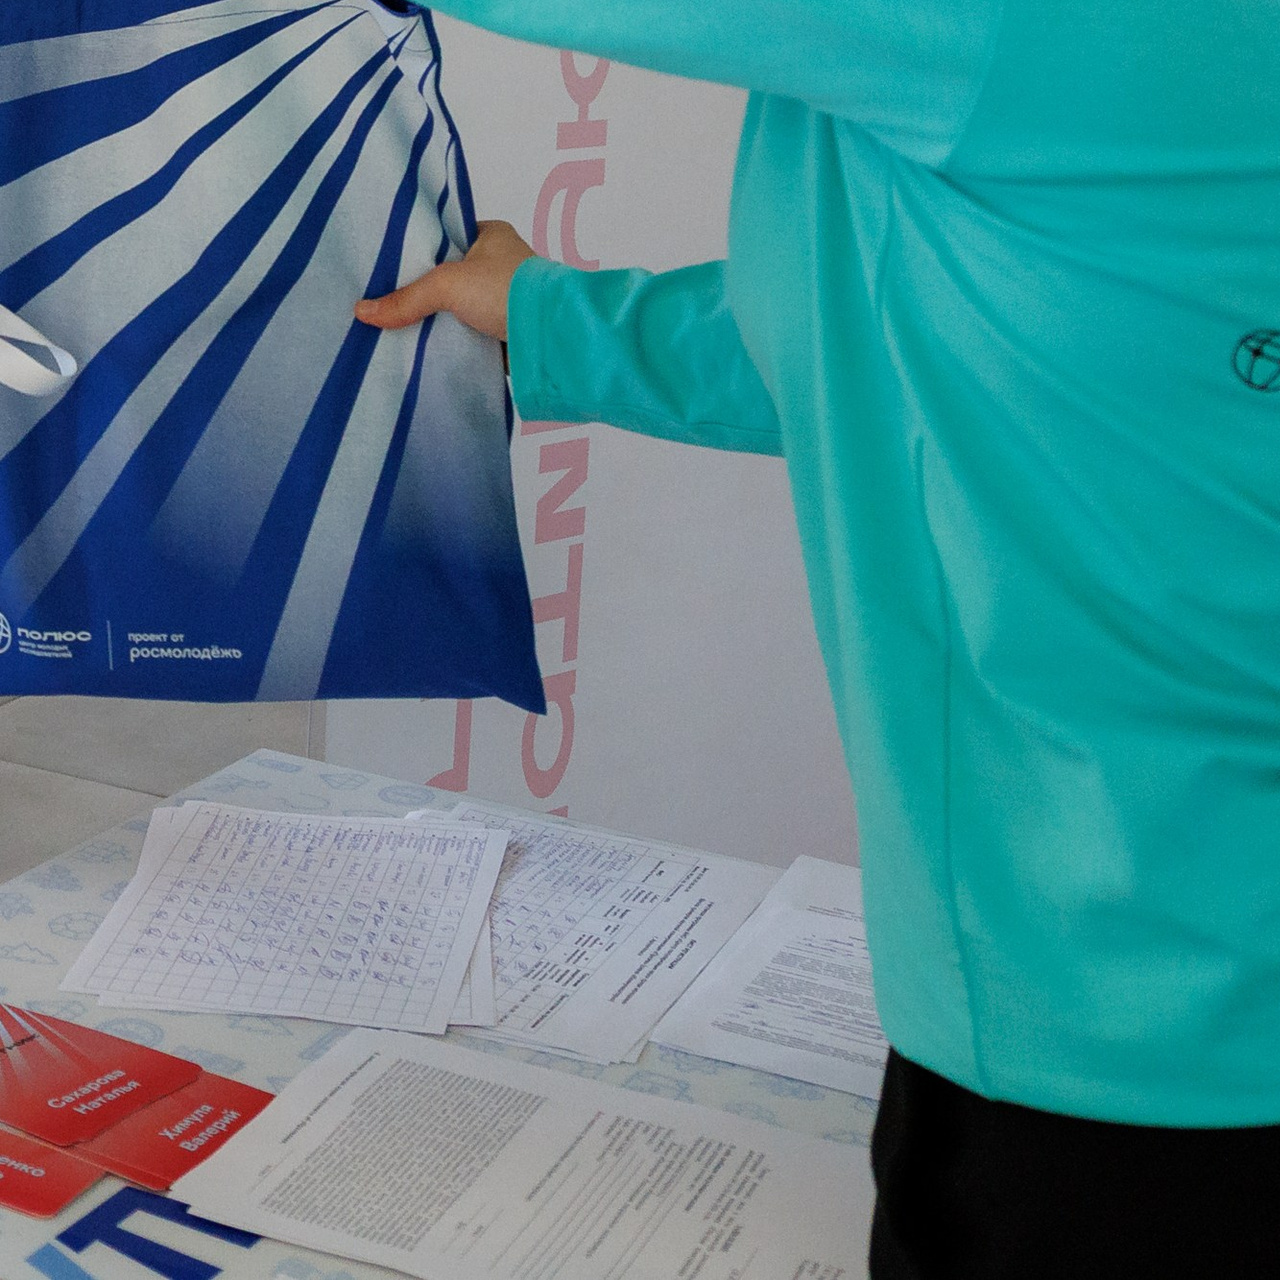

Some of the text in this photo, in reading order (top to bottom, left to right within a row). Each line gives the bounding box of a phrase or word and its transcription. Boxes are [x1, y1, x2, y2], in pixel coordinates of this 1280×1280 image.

[127, 633, 185, 644] проект от
[129, 644, 243, 663] росмолодёжь
[46, 1068, 127, 1109] Сахарова
[72, 1080, 141, 1115] Наталья
[178, 1109, 242, 1152] Валерий
